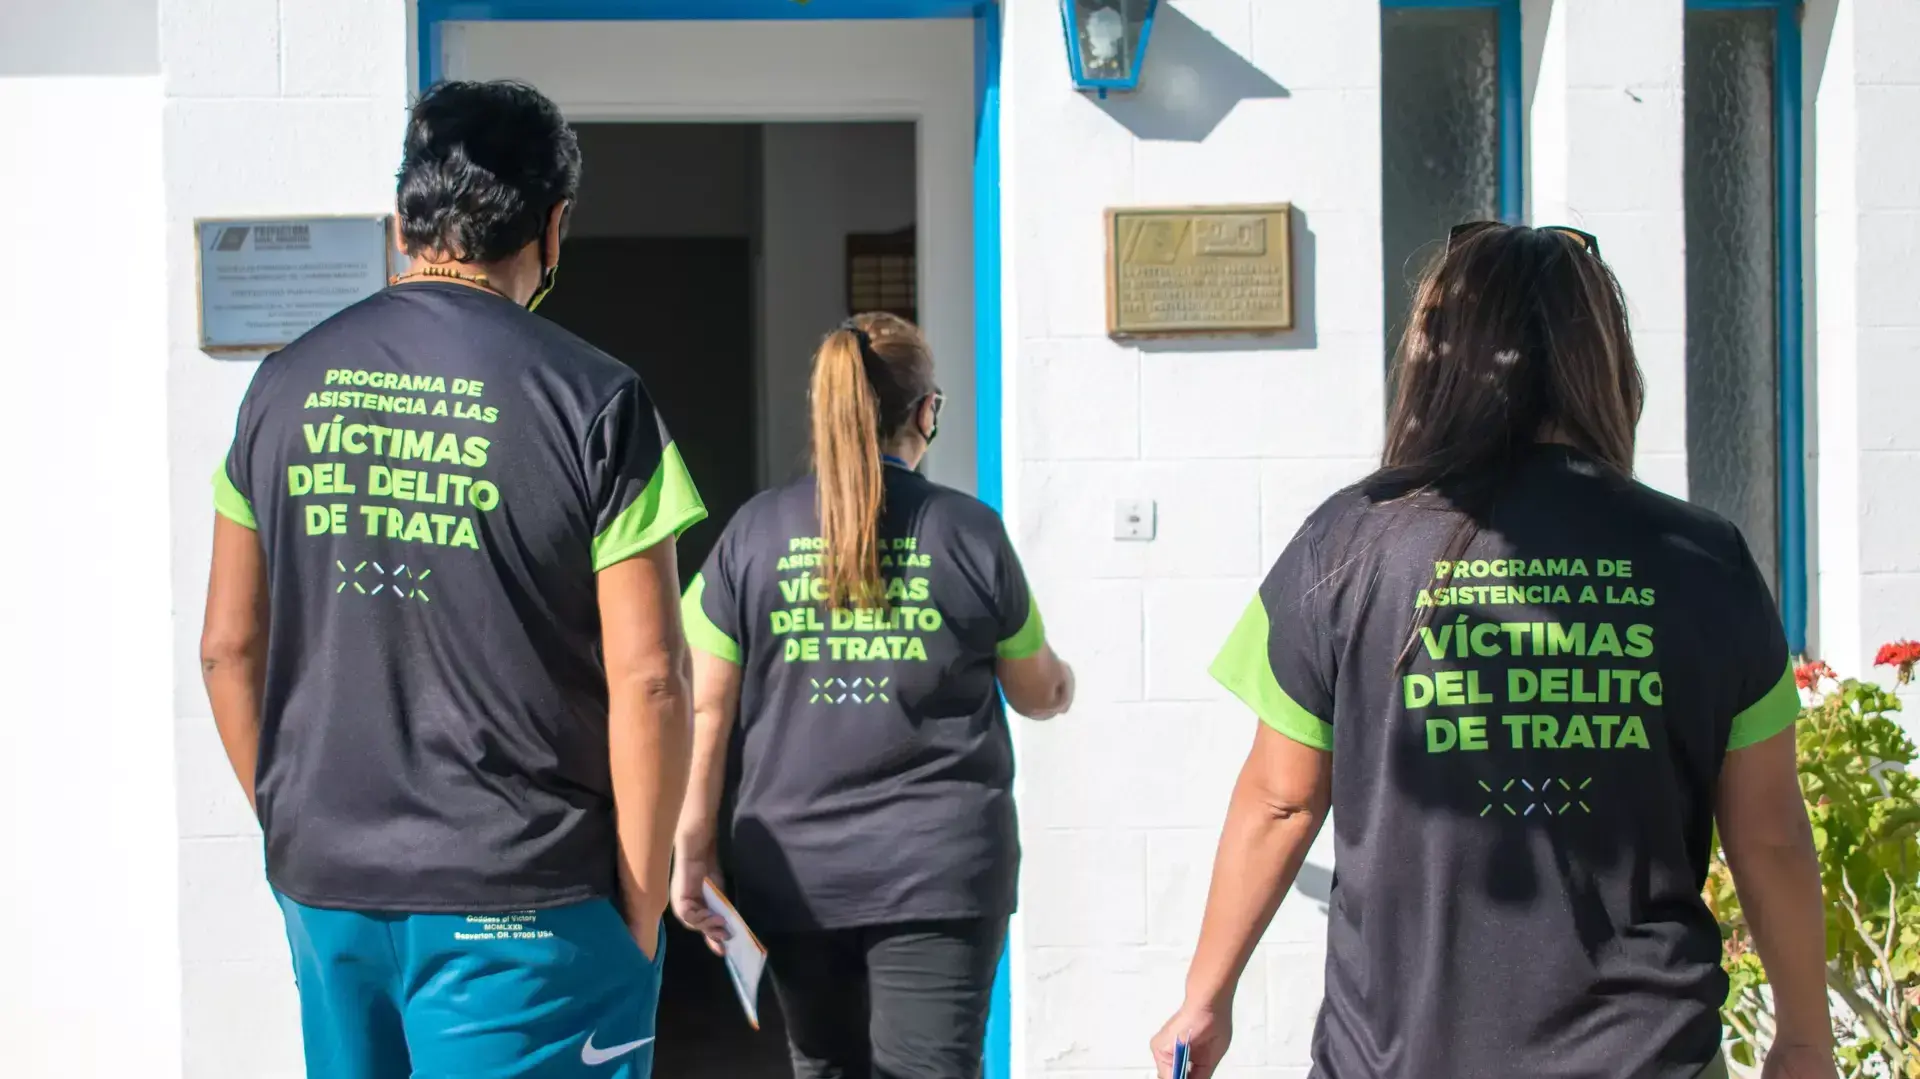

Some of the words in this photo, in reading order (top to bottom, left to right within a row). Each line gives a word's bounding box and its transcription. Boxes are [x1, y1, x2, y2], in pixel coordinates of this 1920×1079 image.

[325, 369, 446, 393] PROGRAMA
[451, 378, 484, 397] DE
[304, 391, 427, 415] ASISTENCIA
[431, 400, 448, 416] A
[453, 402, 499, 423] LAS
[303, 414, 491, 468] VÍCTIMAS
[288, 463, 356, 496] DEL
[368, 465, 499, 511] DELITO
[305, 503, 348, 536] DE
[360, 505, 479, 549] TRATA
[893, 537, 917, 550] DE
[881, 554, 893, 567] A
[898, 553, 932, 568] LAS
[1434, 559, 1589, 580] PROGRAMA
[1597, 559, 1633, 578] DE
[1415, 585, 1571, 608] ASISTENCIA
[1578, 585, 1599, 604] A
[1606, 586, 1655, 607] LAS
[770, 607, 825, 635] DEL
[831, 606, 942, 632] DELITO
[784, 637, 820, 663] DE
[826, 636, 928, 662] TRATA
[1419, 613, 1655, 660] VÍCTIMAS
[1403, 669, 1493, 709] DEL
[1507, 668, 1663, 706] DELITO
[1426, 716, 1489, 753] DE
[1501, 714, 1650, 749] TRATA
[466, 915, 501, 923] Goddess
[502, 915, 510, 923] of
[511, 915, 537, 923] Victory
[537, 930, 554, 938] USA
